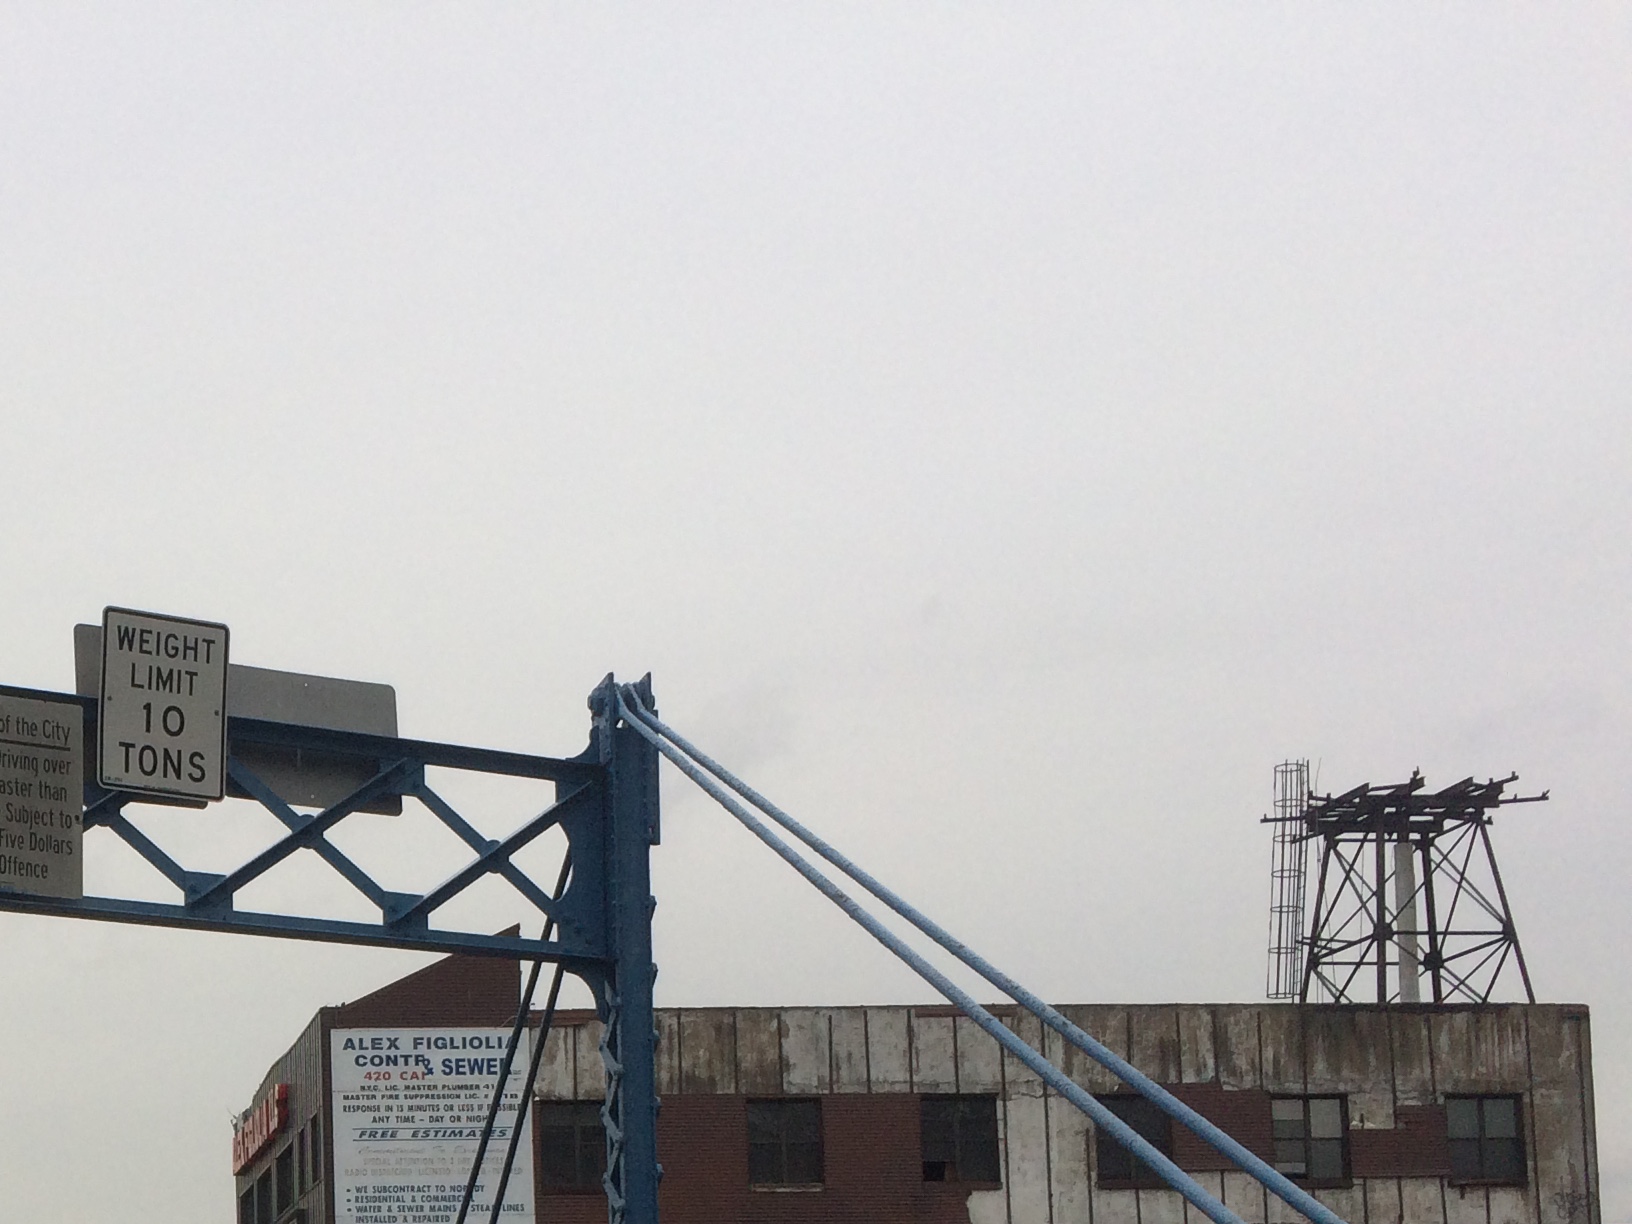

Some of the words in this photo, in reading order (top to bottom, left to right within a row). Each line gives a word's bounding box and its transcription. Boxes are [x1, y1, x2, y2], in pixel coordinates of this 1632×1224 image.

[117, 624, 216, 664] WEIGHT
[130, 662, 198, 696] LIMIT
[142, 702, 185, 737] 10
[16, 717, 38, 737] the
[42, 719, 71, 745] City
[43, 759, 71, 776] over
[118, 741, 206, 783] TONS
[38, 780, 68, 802] than
[6, 802, 54, 830] Subject
[59, 811, 72, 829] to
[29, 832, 73, 855] Dollars
[342, 1037, 400, 1050] ALEX
[423, 1058, 434, 1076] &
[364, 1071, 392, 1081] 420
[404, 1093, 461, 1101] SUPPRESSION
[342, 1104, 381, 1113] RESPONSE
[385, 1104, 394, 1112] IN
[407, 1104, 441, 1112] MINUTES
[443, 1104, 455, 1112] OR
[458, 1103, 475, 1112] LESS
[477, 1104, 484, 1112] IF
[372, 1115, 391, 1123] ANY
[395, 1115, 416, 1123] TIME
[429, 1115, 445, 1123] DAY
[449, 1115, 462, 1123] OR
[466, 1115, 491, 1123] NIGH
[359, 1130, 400, 1138] FREE
[355, 1185, 368, 1194] WE
[372, 1185, 431, 1194] SUBCONTRACT
[435, 1185, 446, 1193] TO
[355, 1205, 382, 1213] WATER
[397, 1205, 425, 1213] SEWER
[429, 1204, 458, 1213] MAINS
[502, 1203, 525, 1212] LINES
[355, 1215, 398, 1223] INSTALLED
[412, 1215, 451, 1223] REPAIRED
